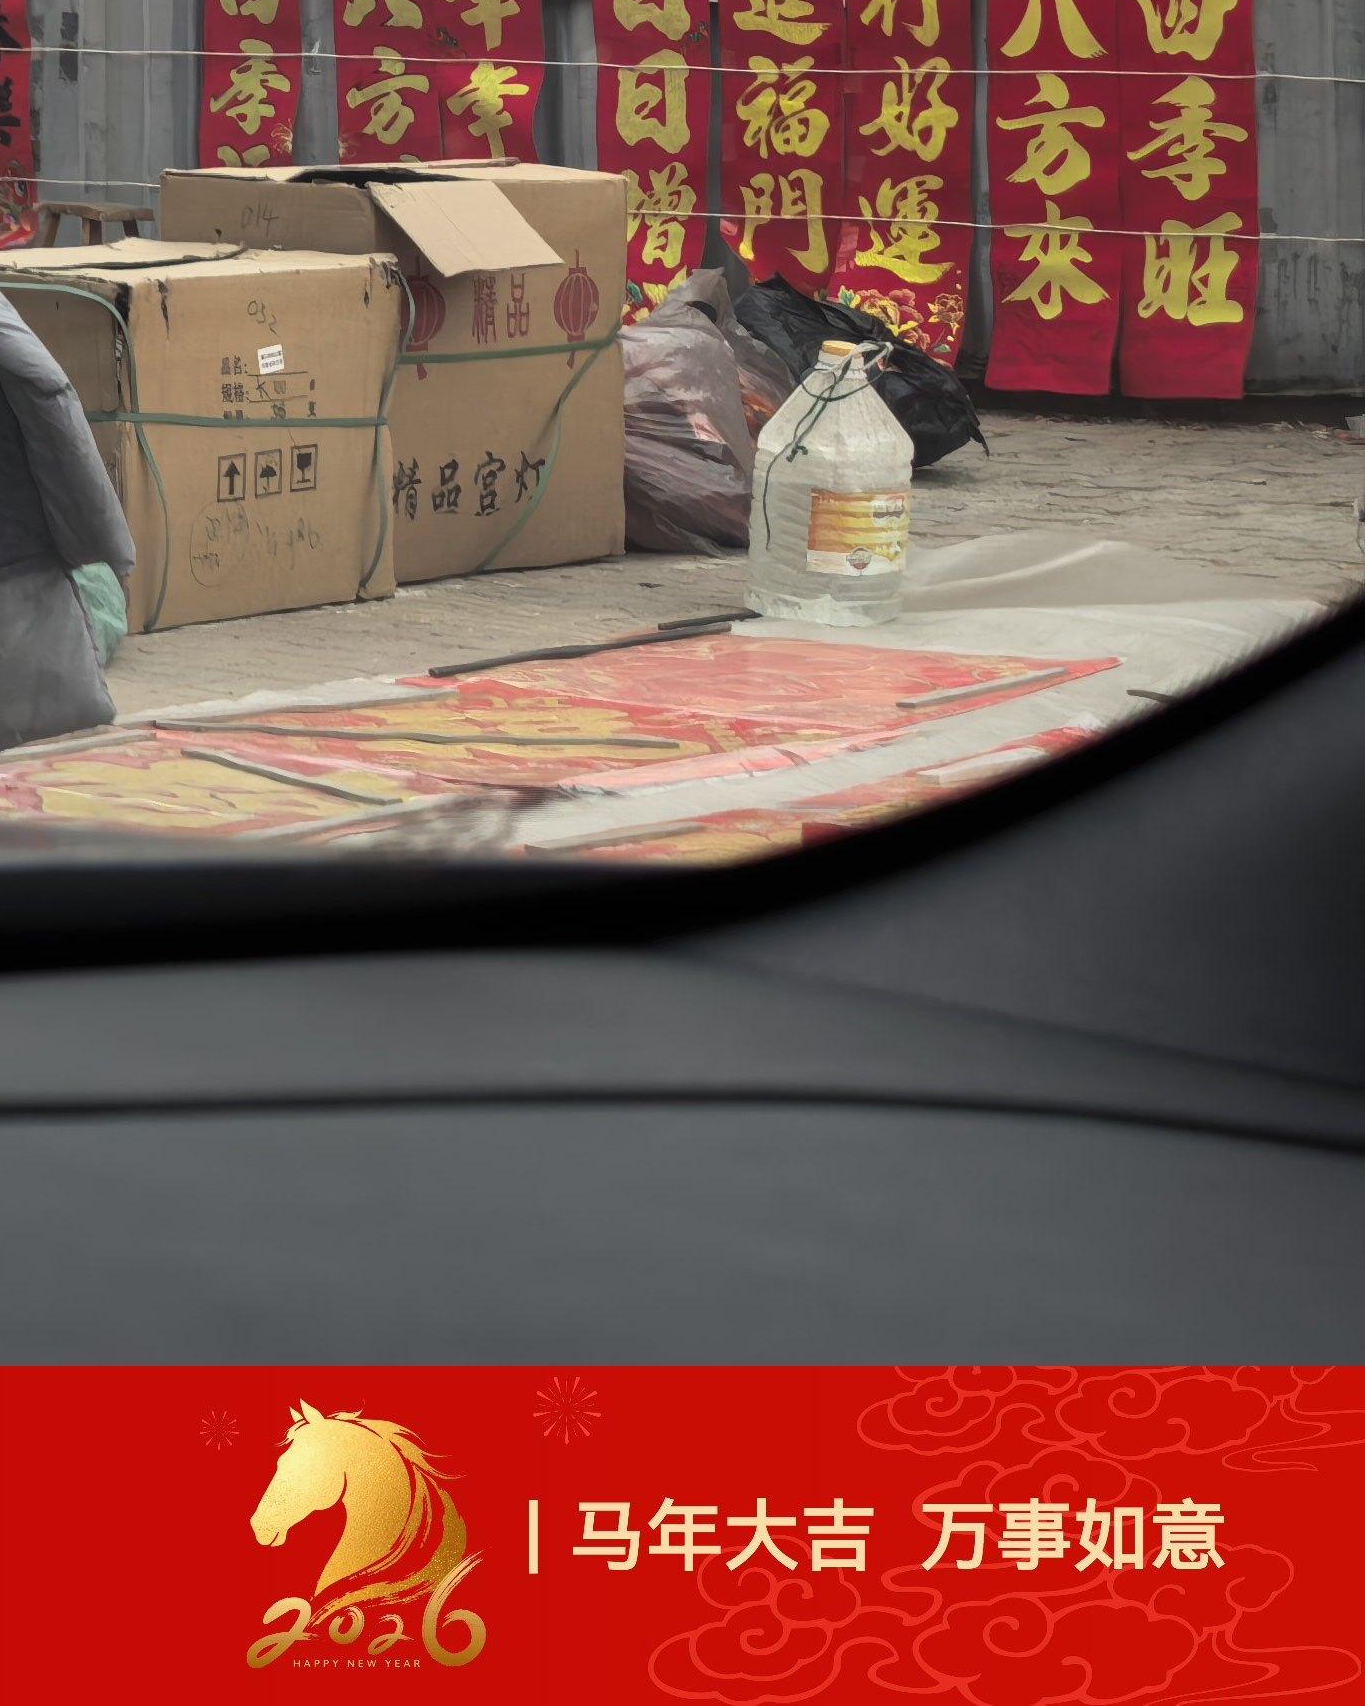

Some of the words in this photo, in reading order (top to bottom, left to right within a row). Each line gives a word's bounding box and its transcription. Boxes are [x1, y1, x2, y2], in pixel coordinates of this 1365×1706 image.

[471, 271, 529, 344] 精品
[392, 450, 546, 520] 精品宫灯
